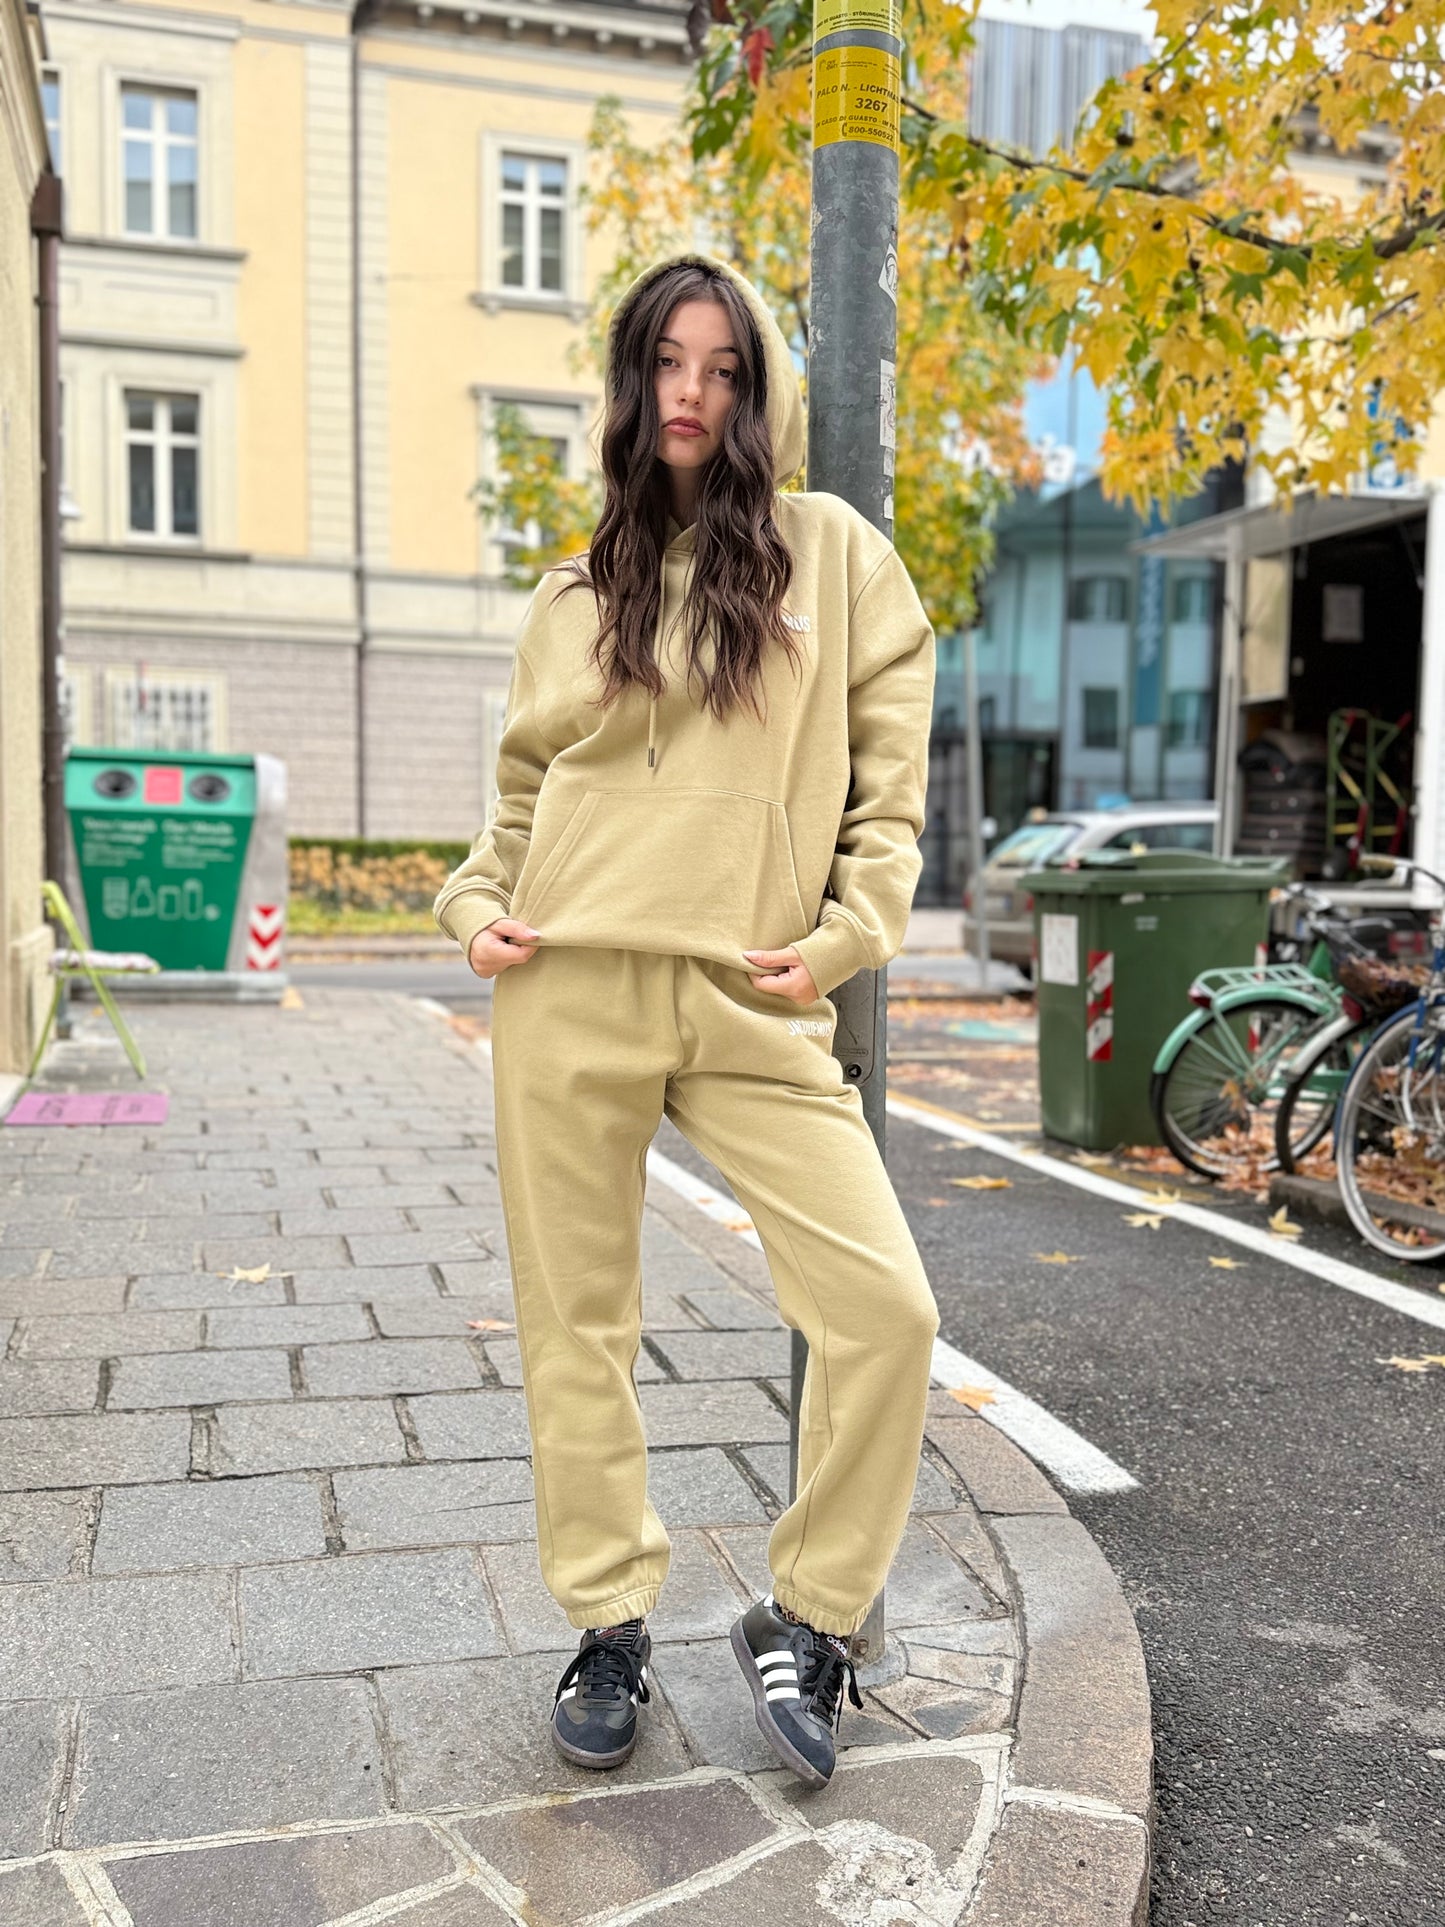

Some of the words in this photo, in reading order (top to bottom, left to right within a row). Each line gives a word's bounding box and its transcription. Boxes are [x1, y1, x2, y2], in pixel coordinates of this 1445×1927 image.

[817, 85, 838, 99] PALO
[855, 97, 888, 113] 3267
[822, 116, 837, 126] CASO
[848, 115, 878, 123] GUASTO
